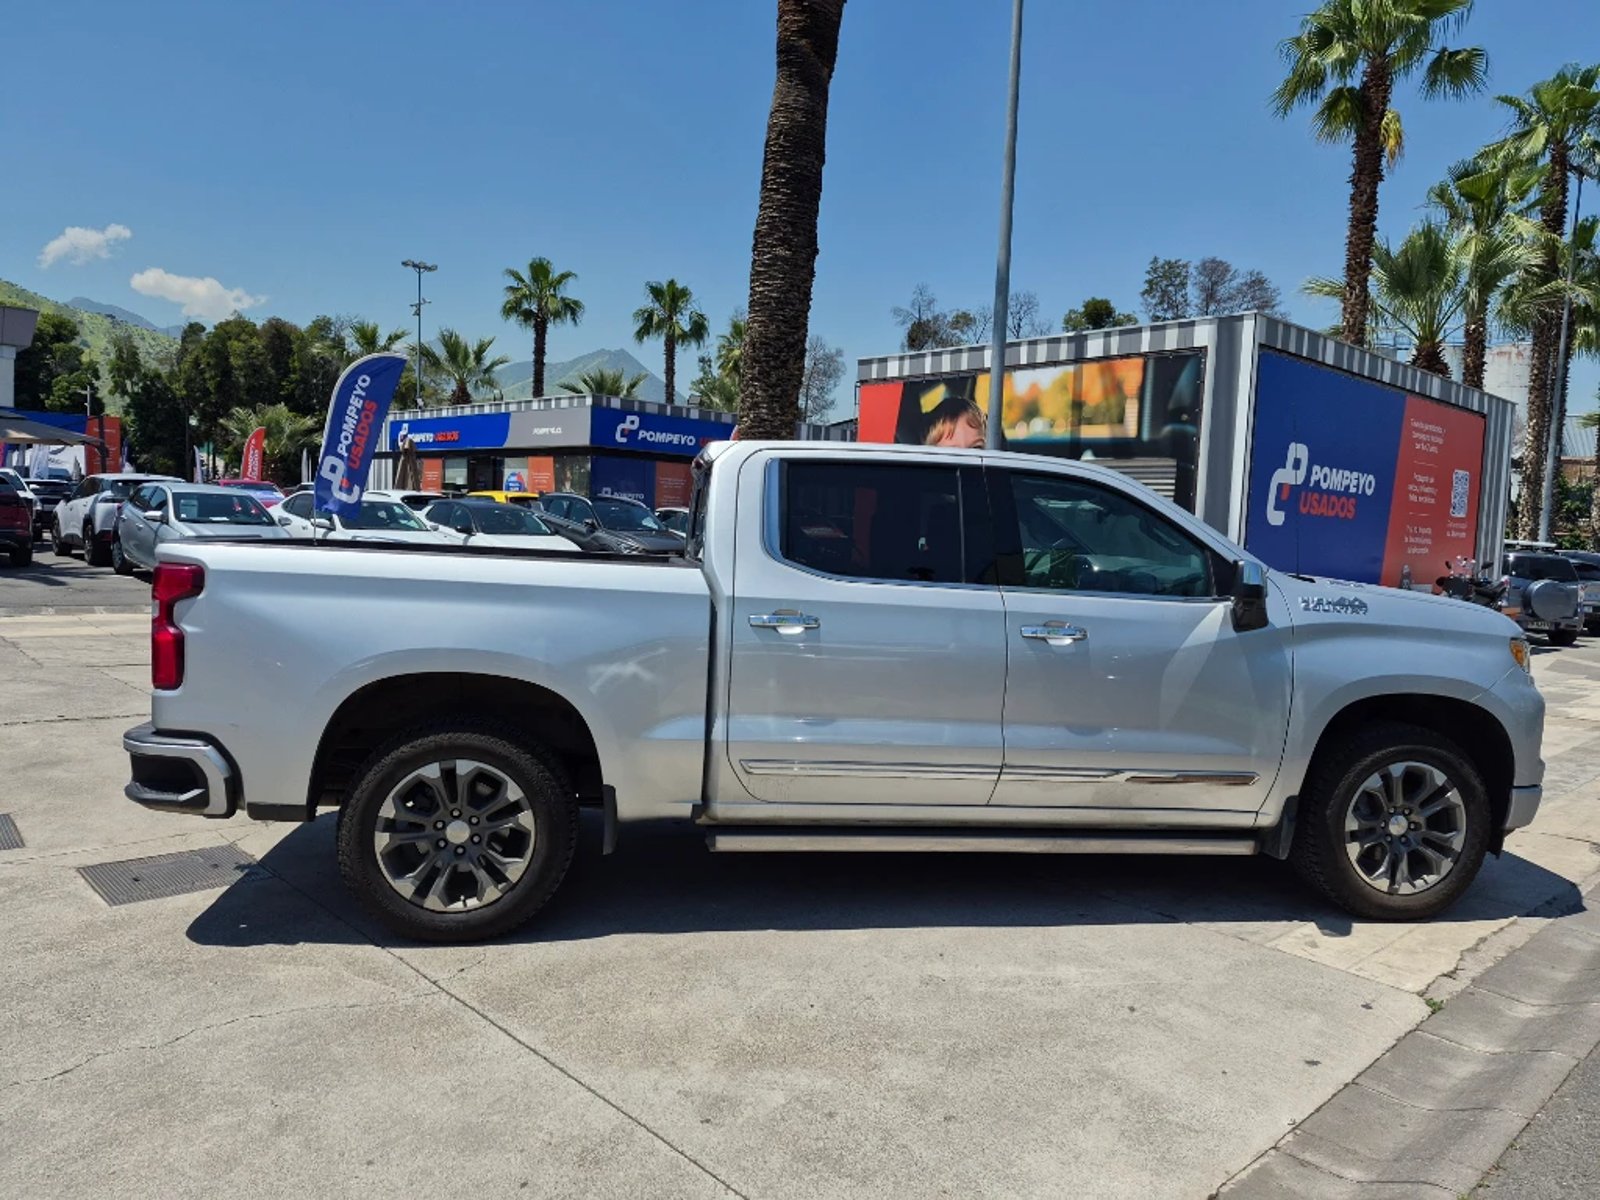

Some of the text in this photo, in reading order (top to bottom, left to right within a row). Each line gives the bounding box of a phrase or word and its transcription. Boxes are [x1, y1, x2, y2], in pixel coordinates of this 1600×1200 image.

[337, 374, 371, 457] POMPEYO
[349, 400, 378, 469] USADOS
[638, 430, 696, 446] POMPEYO
[1309, 464, 1376, 496] POMPEYO
[1300, 491, 1357, 520] USADOS
